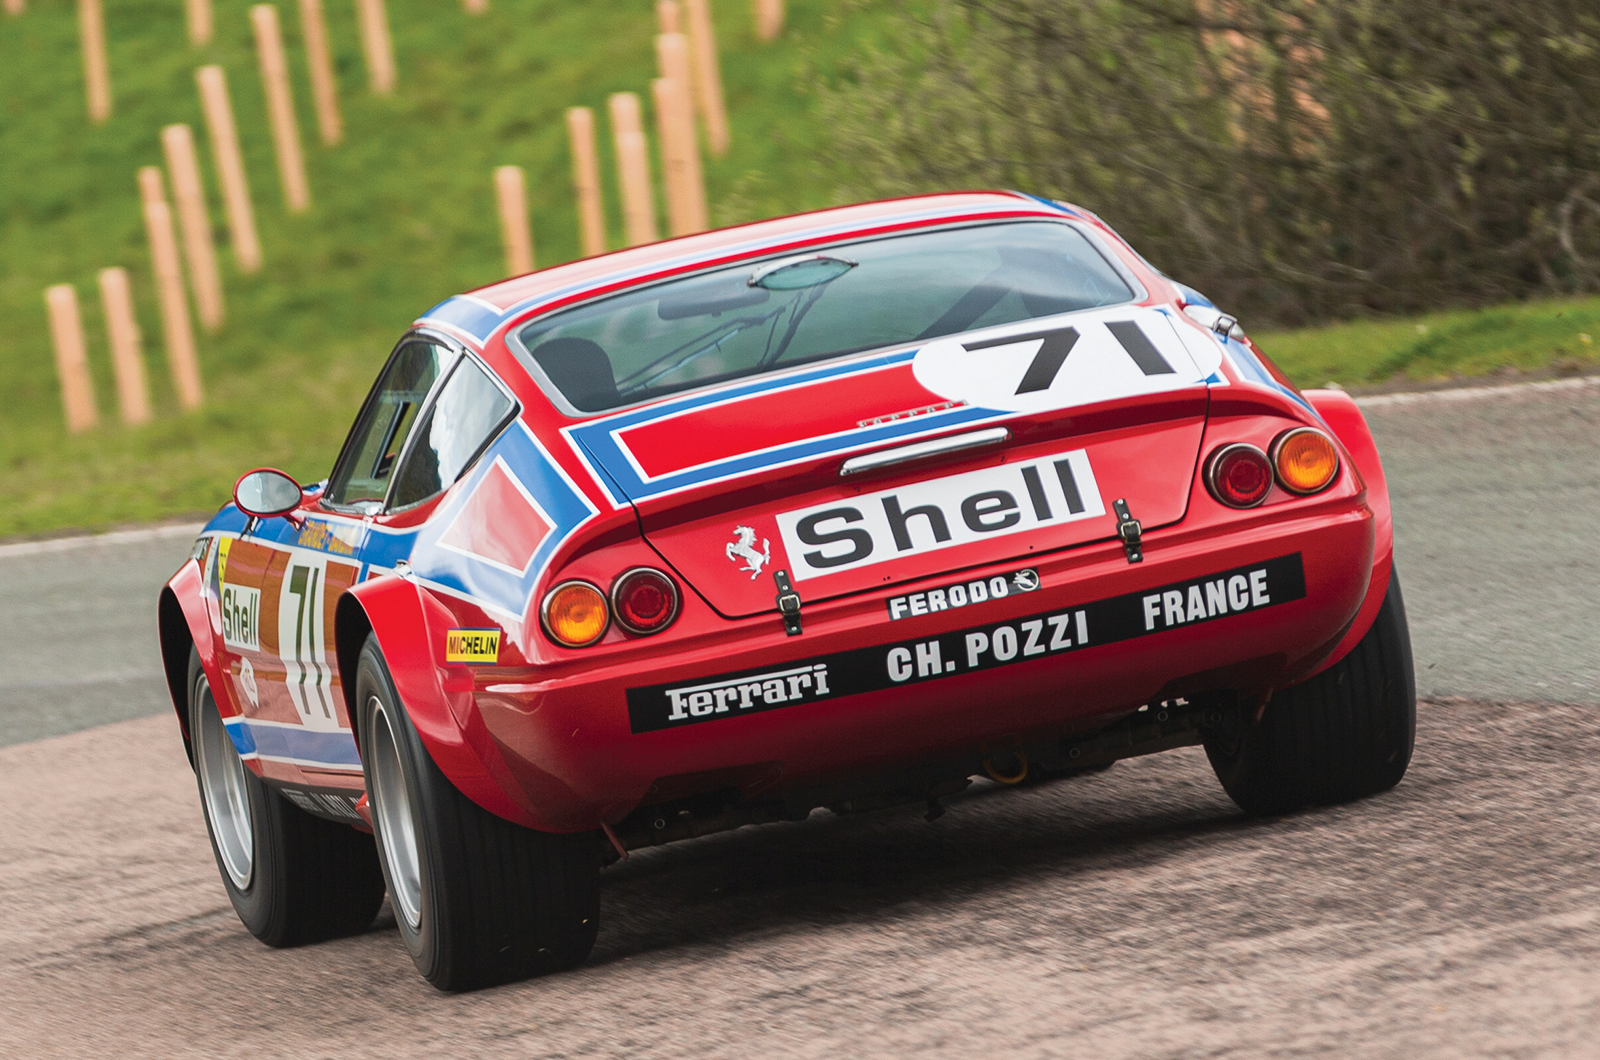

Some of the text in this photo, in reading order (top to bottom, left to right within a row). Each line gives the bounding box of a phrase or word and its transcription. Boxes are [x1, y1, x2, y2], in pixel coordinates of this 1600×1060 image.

[959, 319, 1177, 396] 71
[794, 457, 1086, 570] Shell
[223, 588, 258, 647] Shell
[889, 576, 1009, 620] FERODO
[289, 564, 332, 720] 71
[448, 636, 498, 655] MICHELIN
[665, 568, 1271, 721] Ferrari CH. POZZI FRANCE
